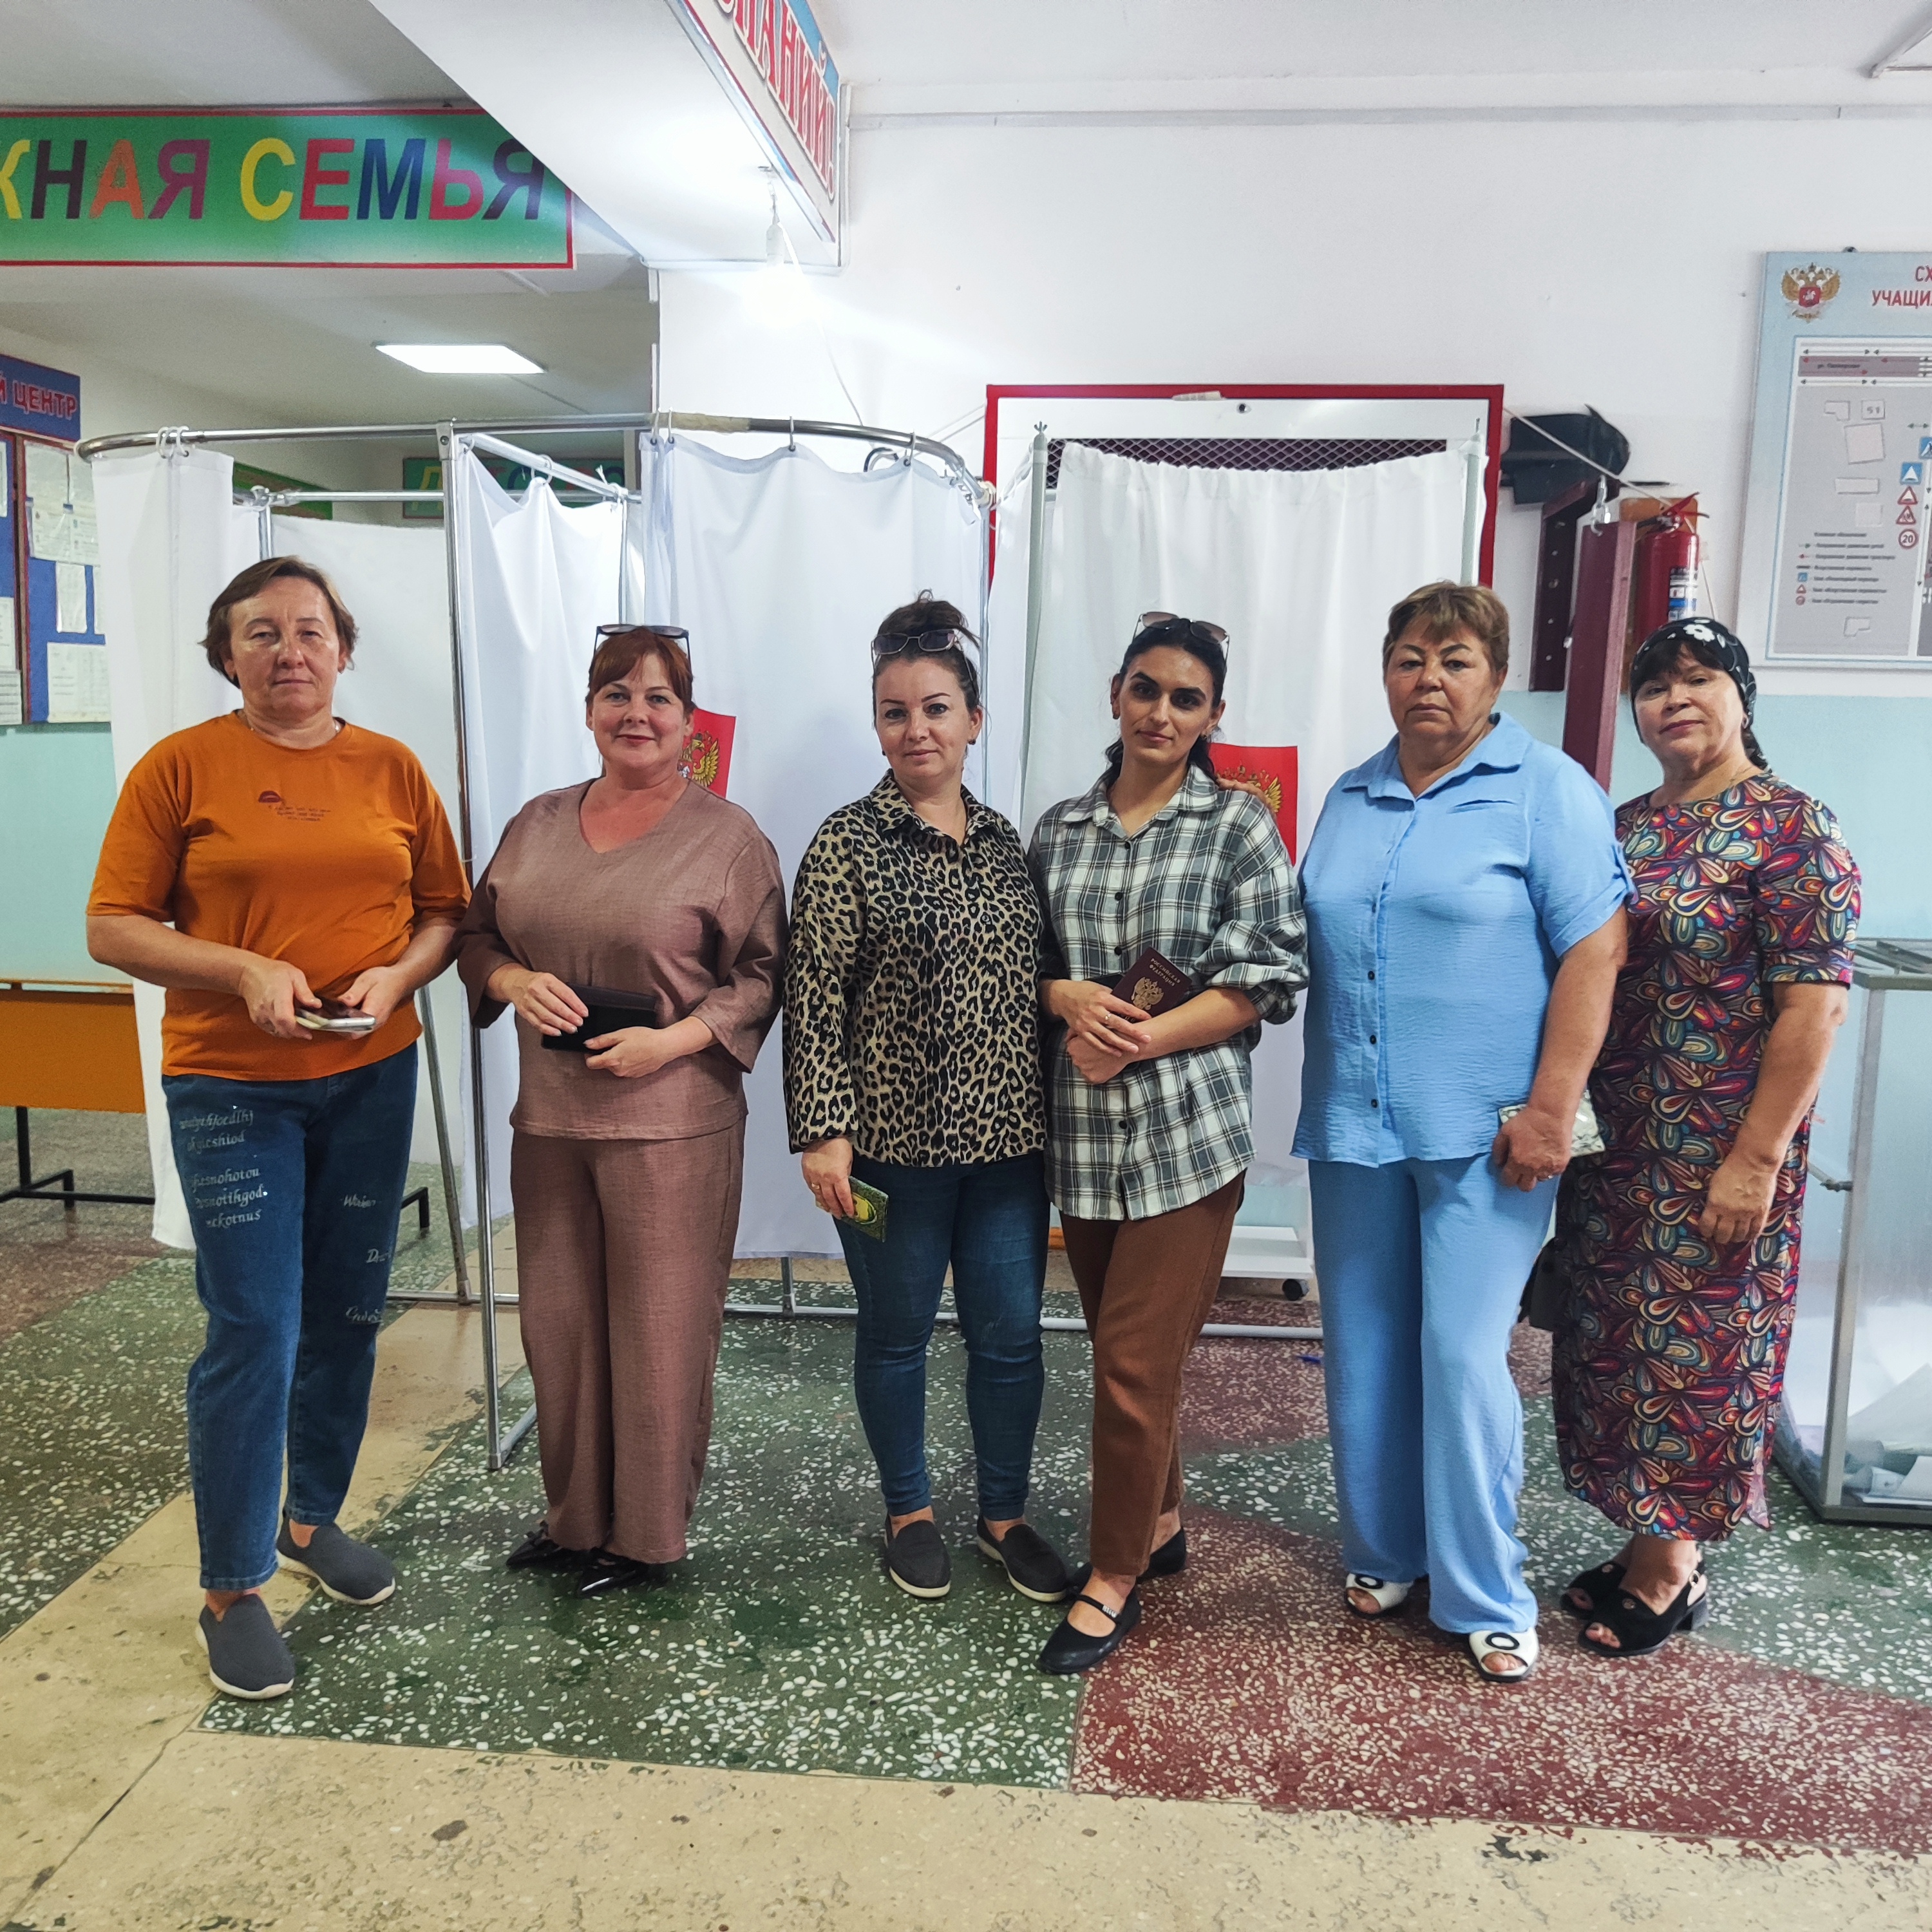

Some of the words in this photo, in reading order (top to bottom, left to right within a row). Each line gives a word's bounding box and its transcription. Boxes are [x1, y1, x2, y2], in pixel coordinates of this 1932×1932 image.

[240, 137, 547, 221] СЕМЬЯ
[1871, 289, 1932, 309] УЧАЩИ
[13, 380, 77, 420] ЦЕНТР
[1903, 534, 1913, 544] 20
